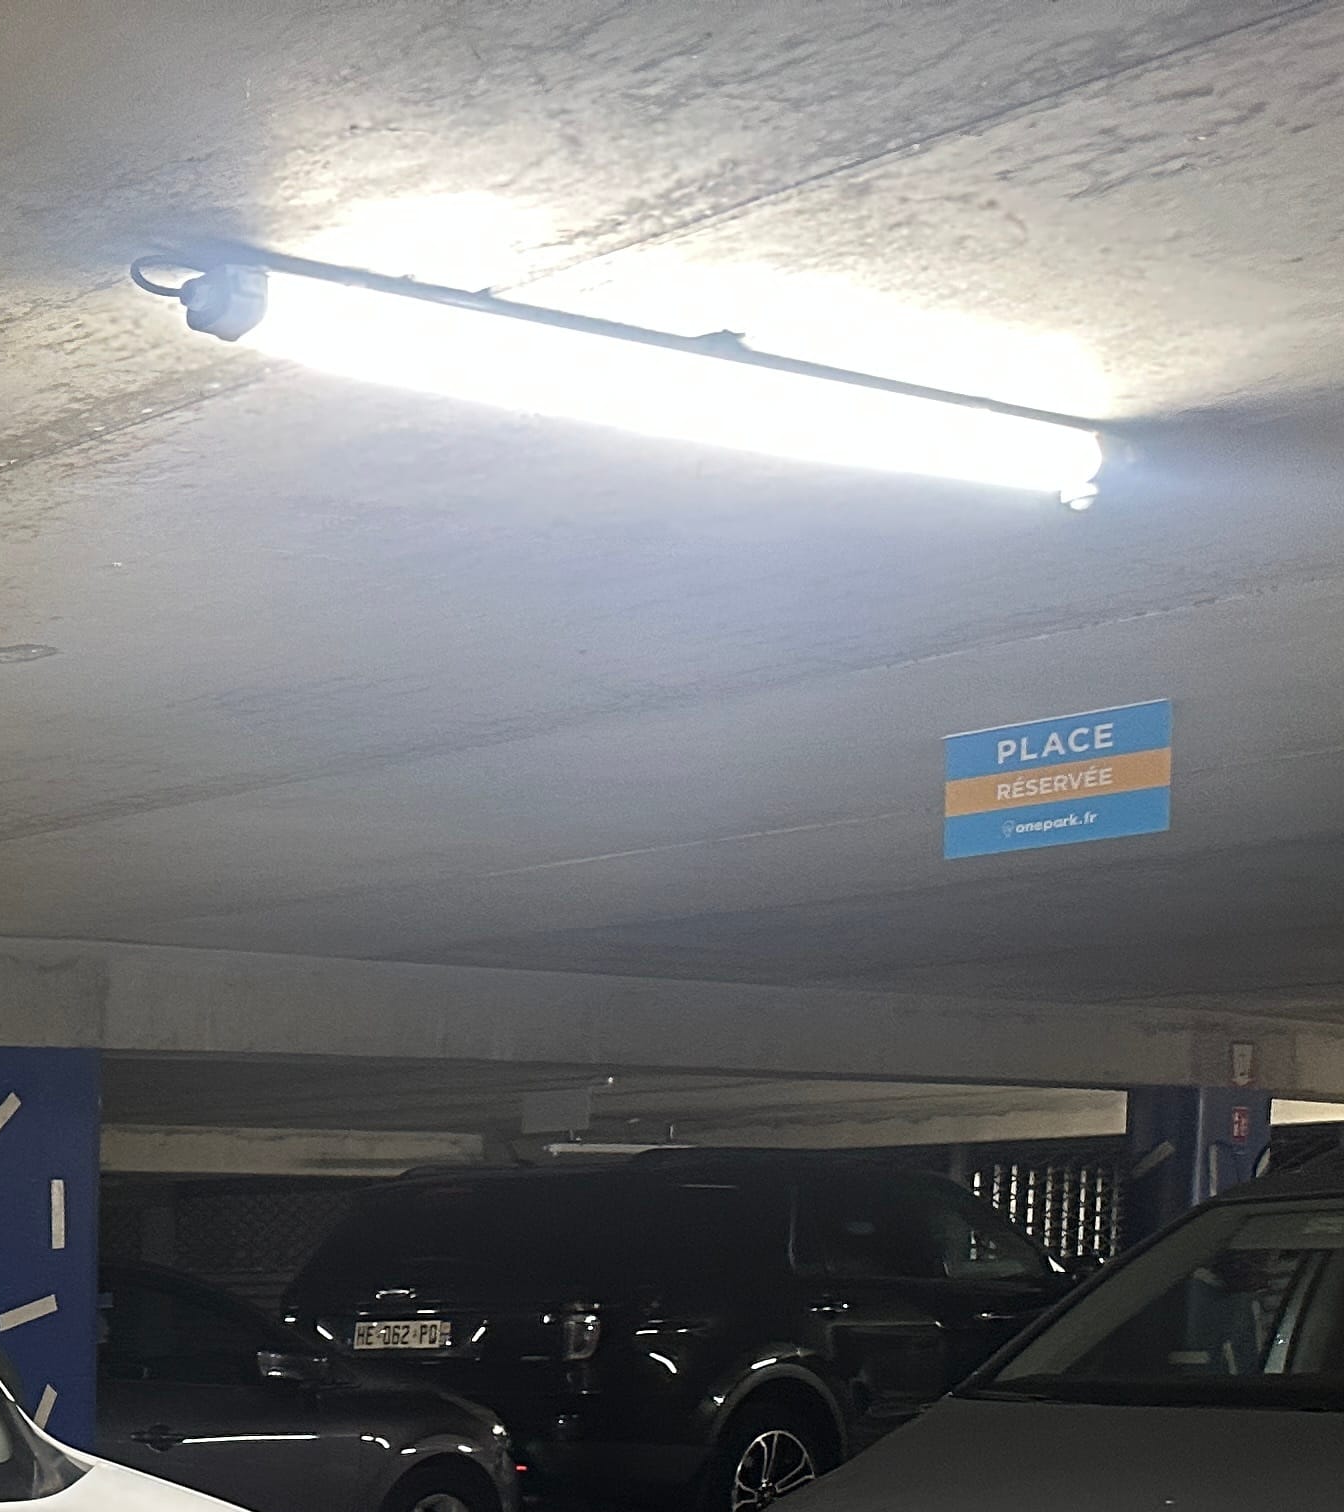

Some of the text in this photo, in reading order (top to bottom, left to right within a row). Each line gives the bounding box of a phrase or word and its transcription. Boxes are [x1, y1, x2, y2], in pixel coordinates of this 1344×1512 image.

[997, 722, 1114, 764] PLACE
[996, 766, 1113, 801] RÉSERVÉE
[1015, 811, 1098, 833] onepark.fr
